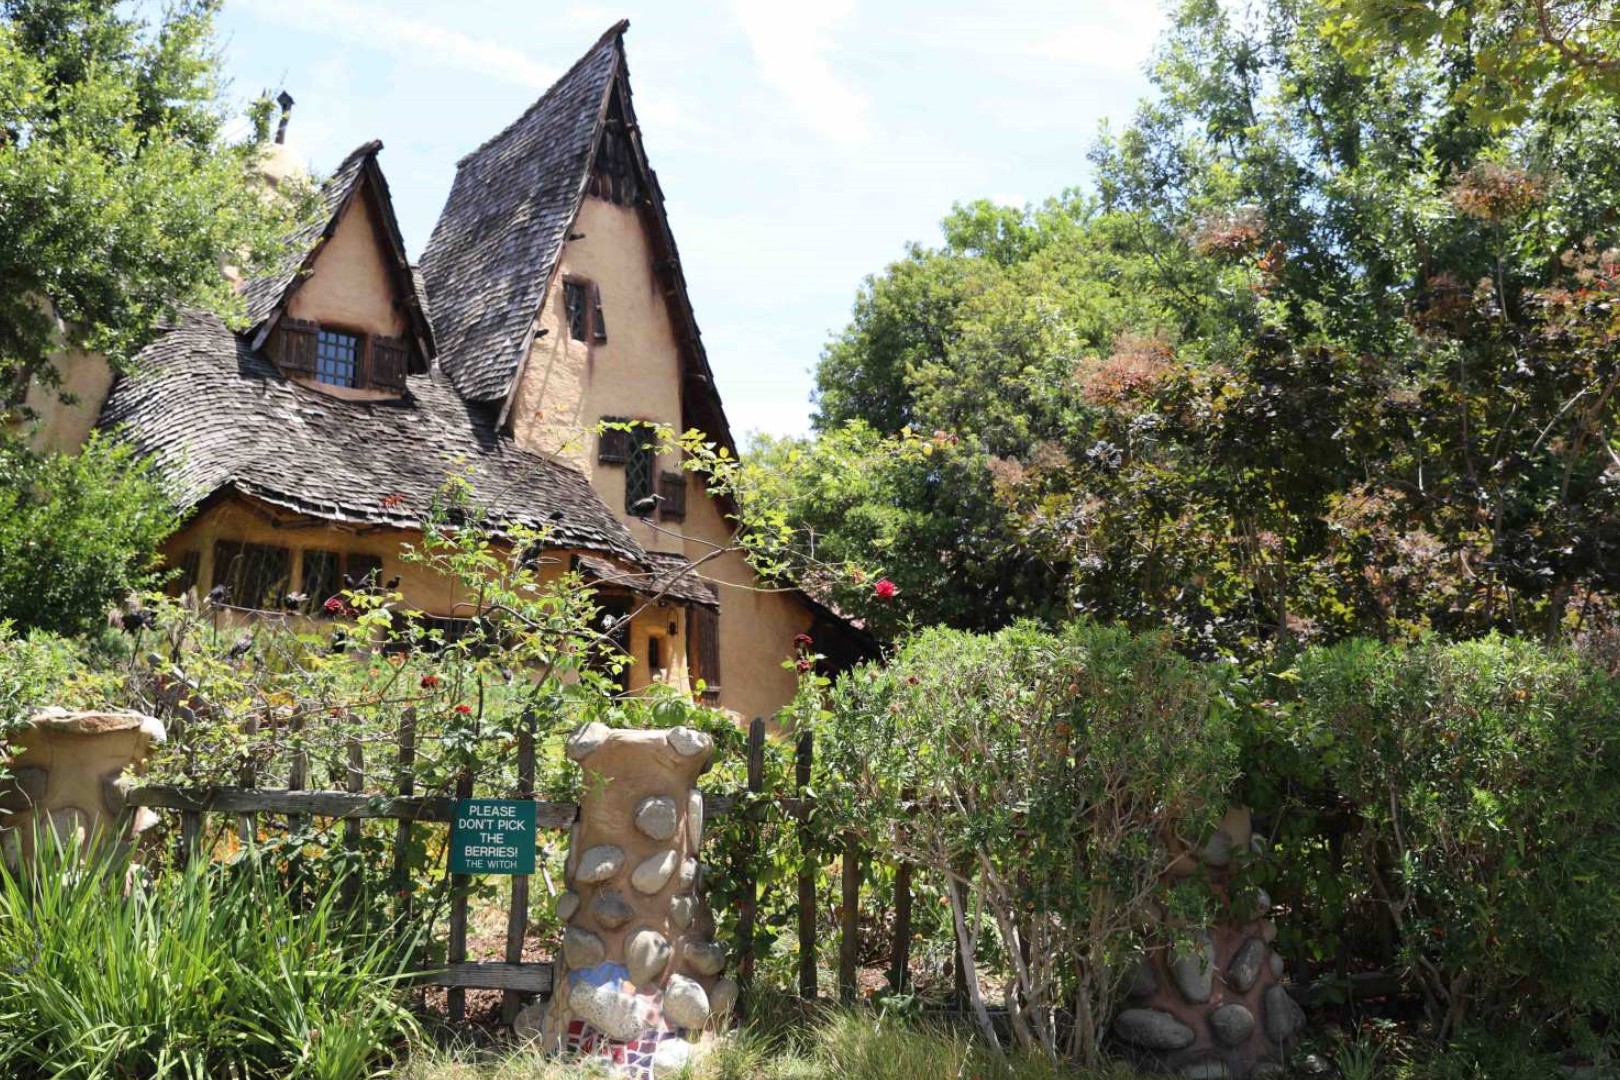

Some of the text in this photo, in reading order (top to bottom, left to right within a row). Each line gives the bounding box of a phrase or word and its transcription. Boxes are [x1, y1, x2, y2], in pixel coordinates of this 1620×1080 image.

[469, 805, 516, 817] PLEASE
[459, 818, 526, 831] DON'T PICK
[480, 832, 504, 844] THE
[465, 846, 518, 858] BERRIES!
[465, 859, 517, 869] THE WITCH
